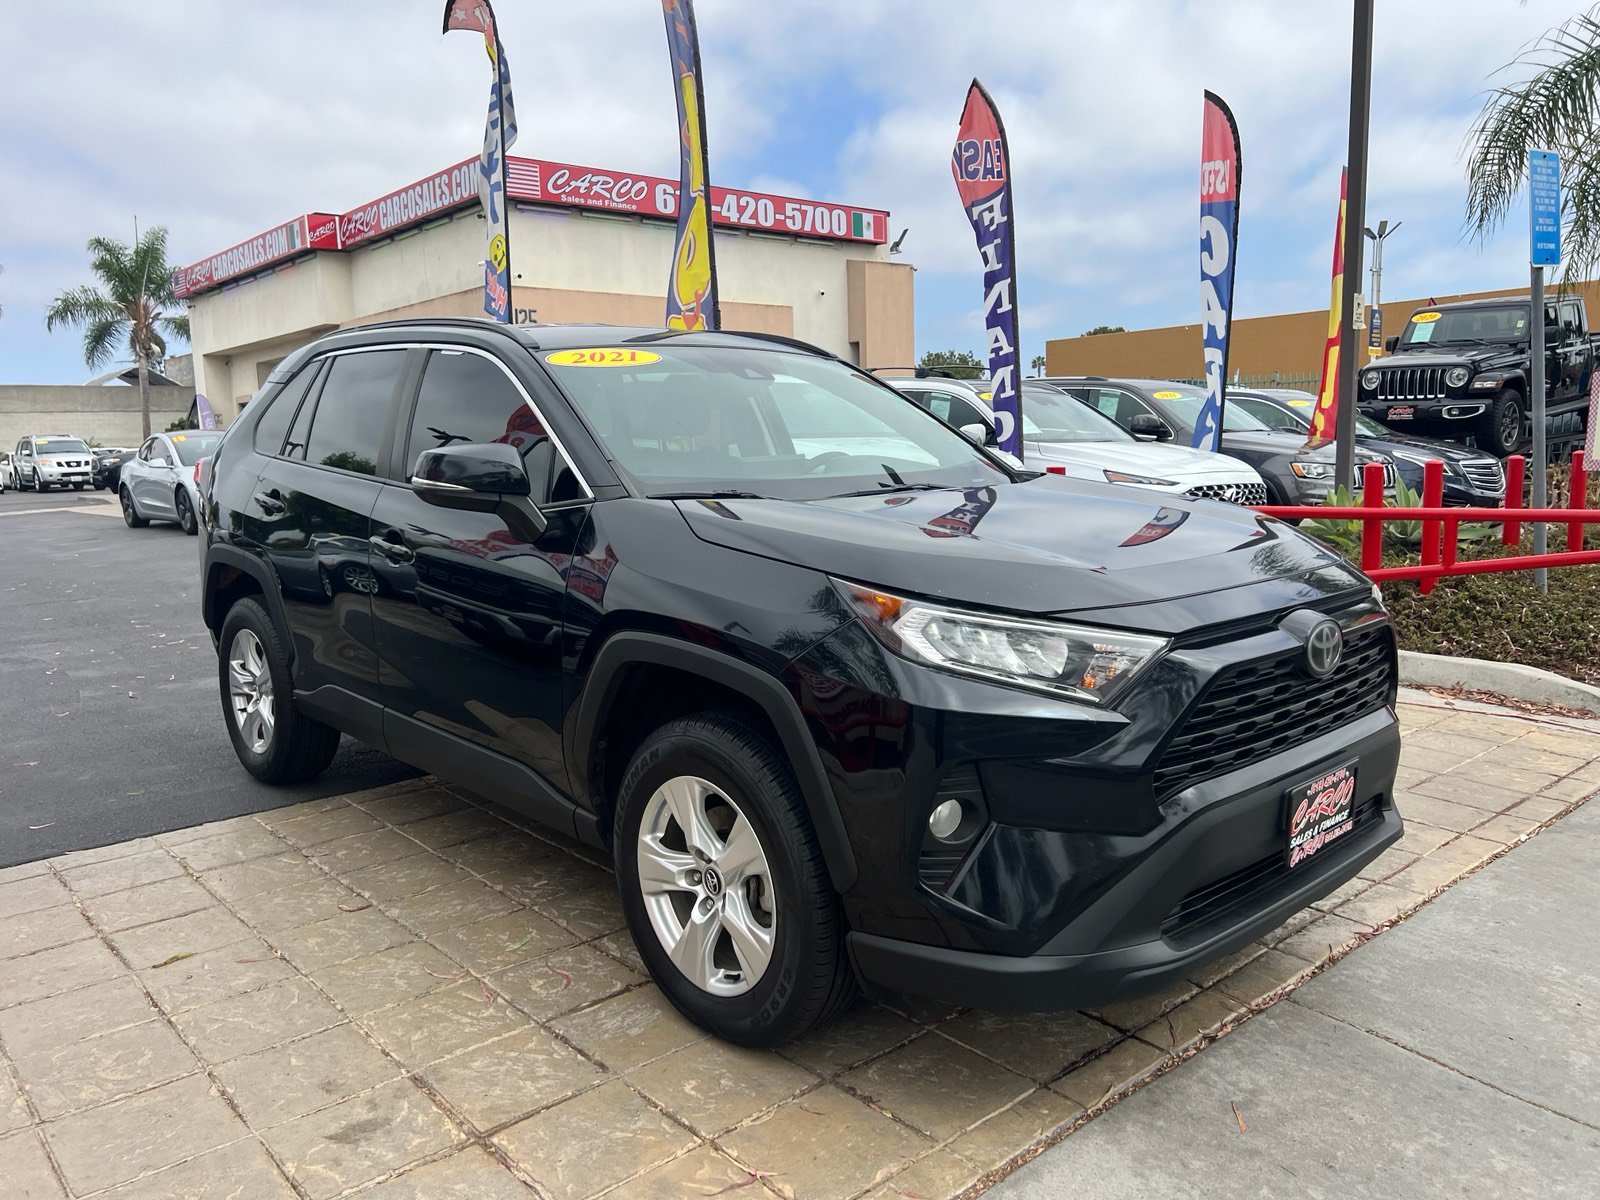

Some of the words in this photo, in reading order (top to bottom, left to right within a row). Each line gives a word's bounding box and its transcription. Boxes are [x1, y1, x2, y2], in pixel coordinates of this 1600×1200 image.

[340, 205, 379, 242] CARCO
[379, 160, 481, 230] CARCOSALES.COM
[547, 169, 648, 203] CARCO
[655, 183, 848, 236] 6-420-5700
[561, 194, 585, 204] Sales
[587, 199, 603, 207] and
[605, 201, 637, 211] Finance
[308, 221, 336, 242] CARCO
[211, 230, 288, 281] CARCOSALES.COM
[571, 351, 639, 364] 2021
[1290, 776, 1355, 836] CARCO
[1290, 828, 1314, 849] SALES
[1319, 809, 1350, 833] FINANCE
